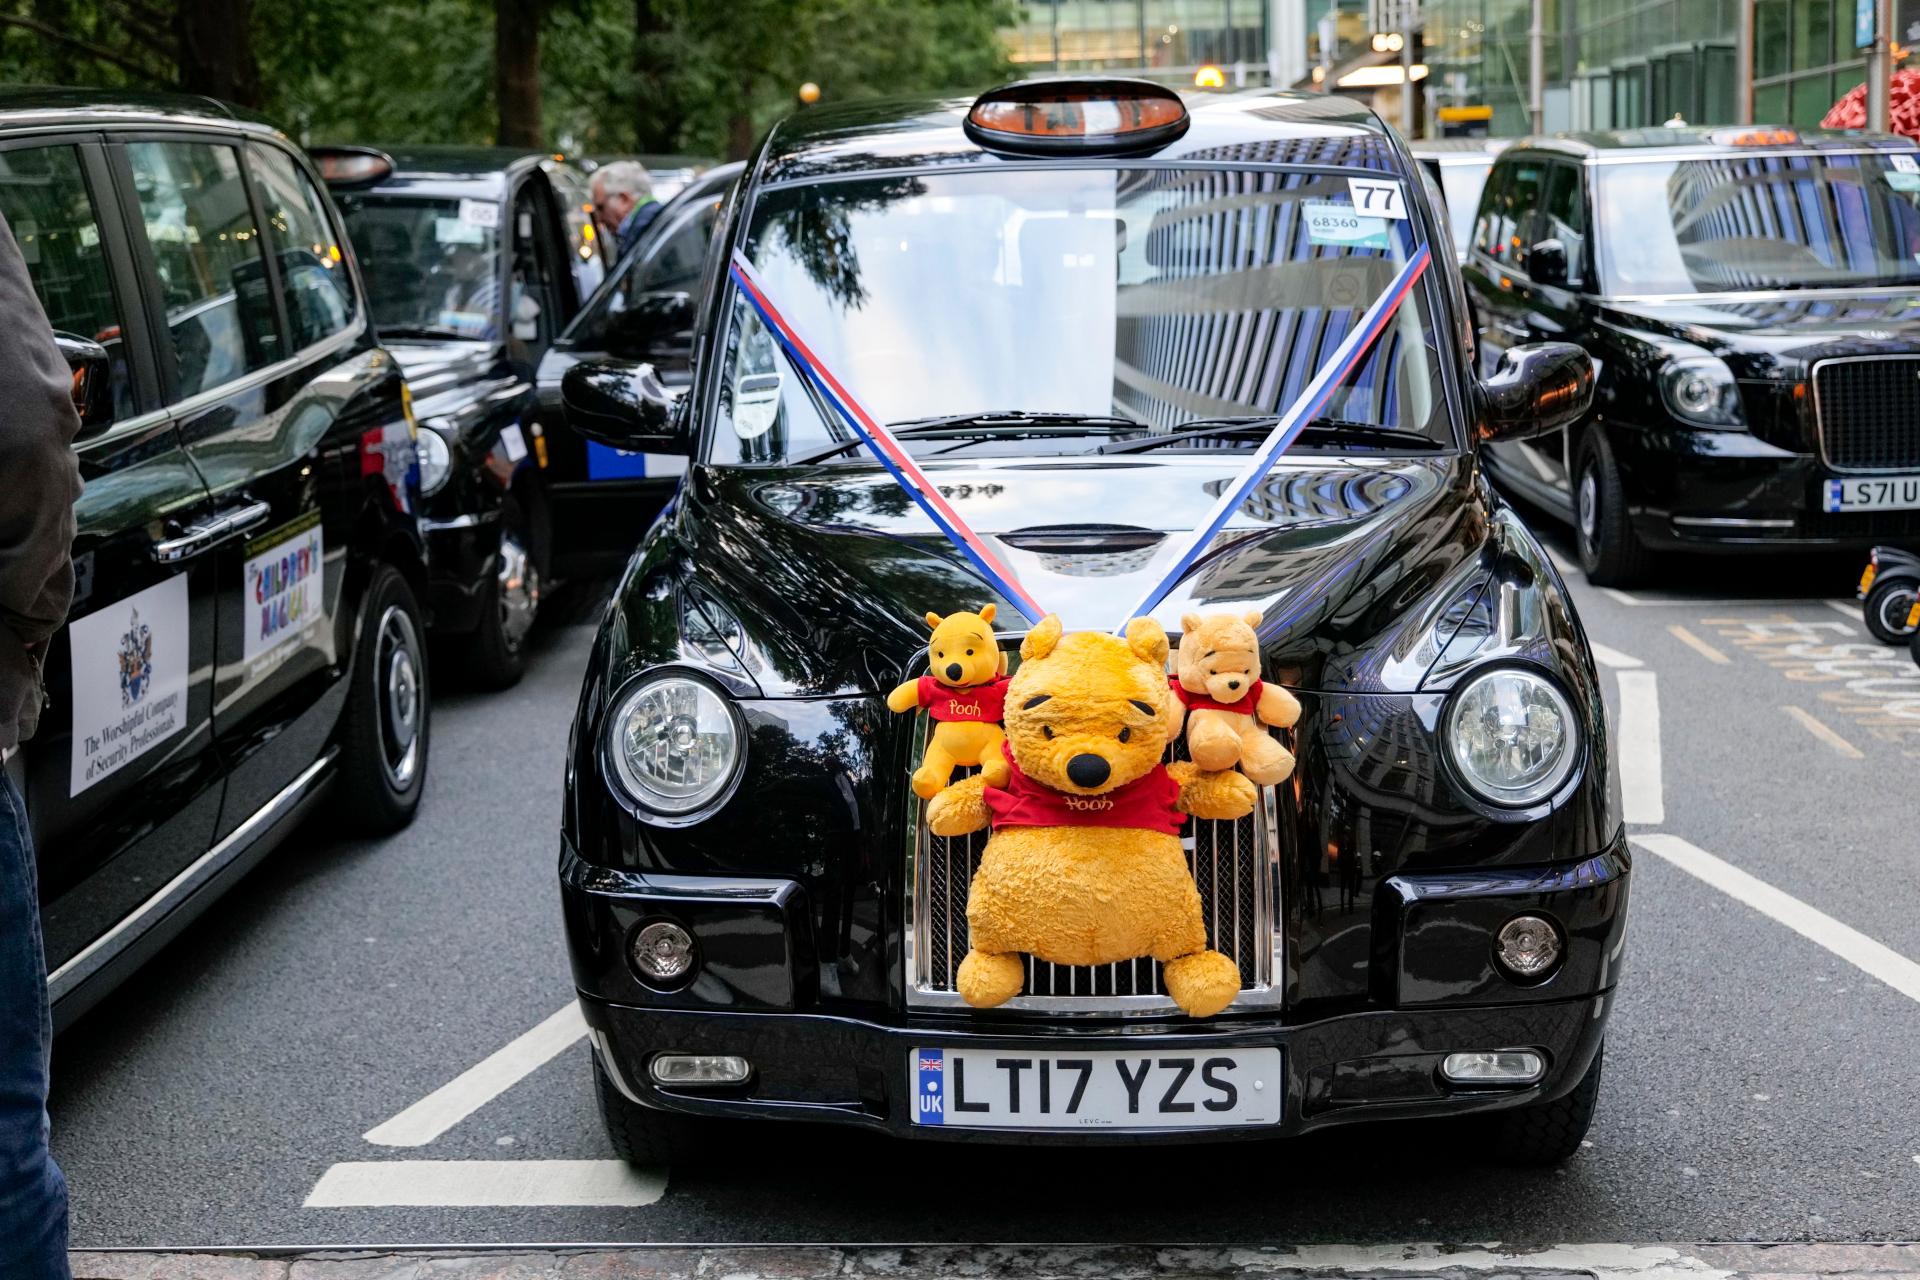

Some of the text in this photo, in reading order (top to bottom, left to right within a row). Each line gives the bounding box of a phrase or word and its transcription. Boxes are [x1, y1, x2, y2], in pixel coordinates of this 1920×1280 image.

[1014, 96, 1142, 131] TAI
[1355, 185, 1395, 210] 77
[1312, 217, 1358, 229] 68360
[1840, 482, 1895, 504] LS71
[949, 698, 981, 717] Pooh
[84, 735, 100, 757] The
[102, 706, 145, 745] Worshipful
[86, 711, 175, 781] of Security Professionals
[1062, 795, 1114, 811] Pooh
[919, 1057, 1239, 1115] UK LT17 YZS
